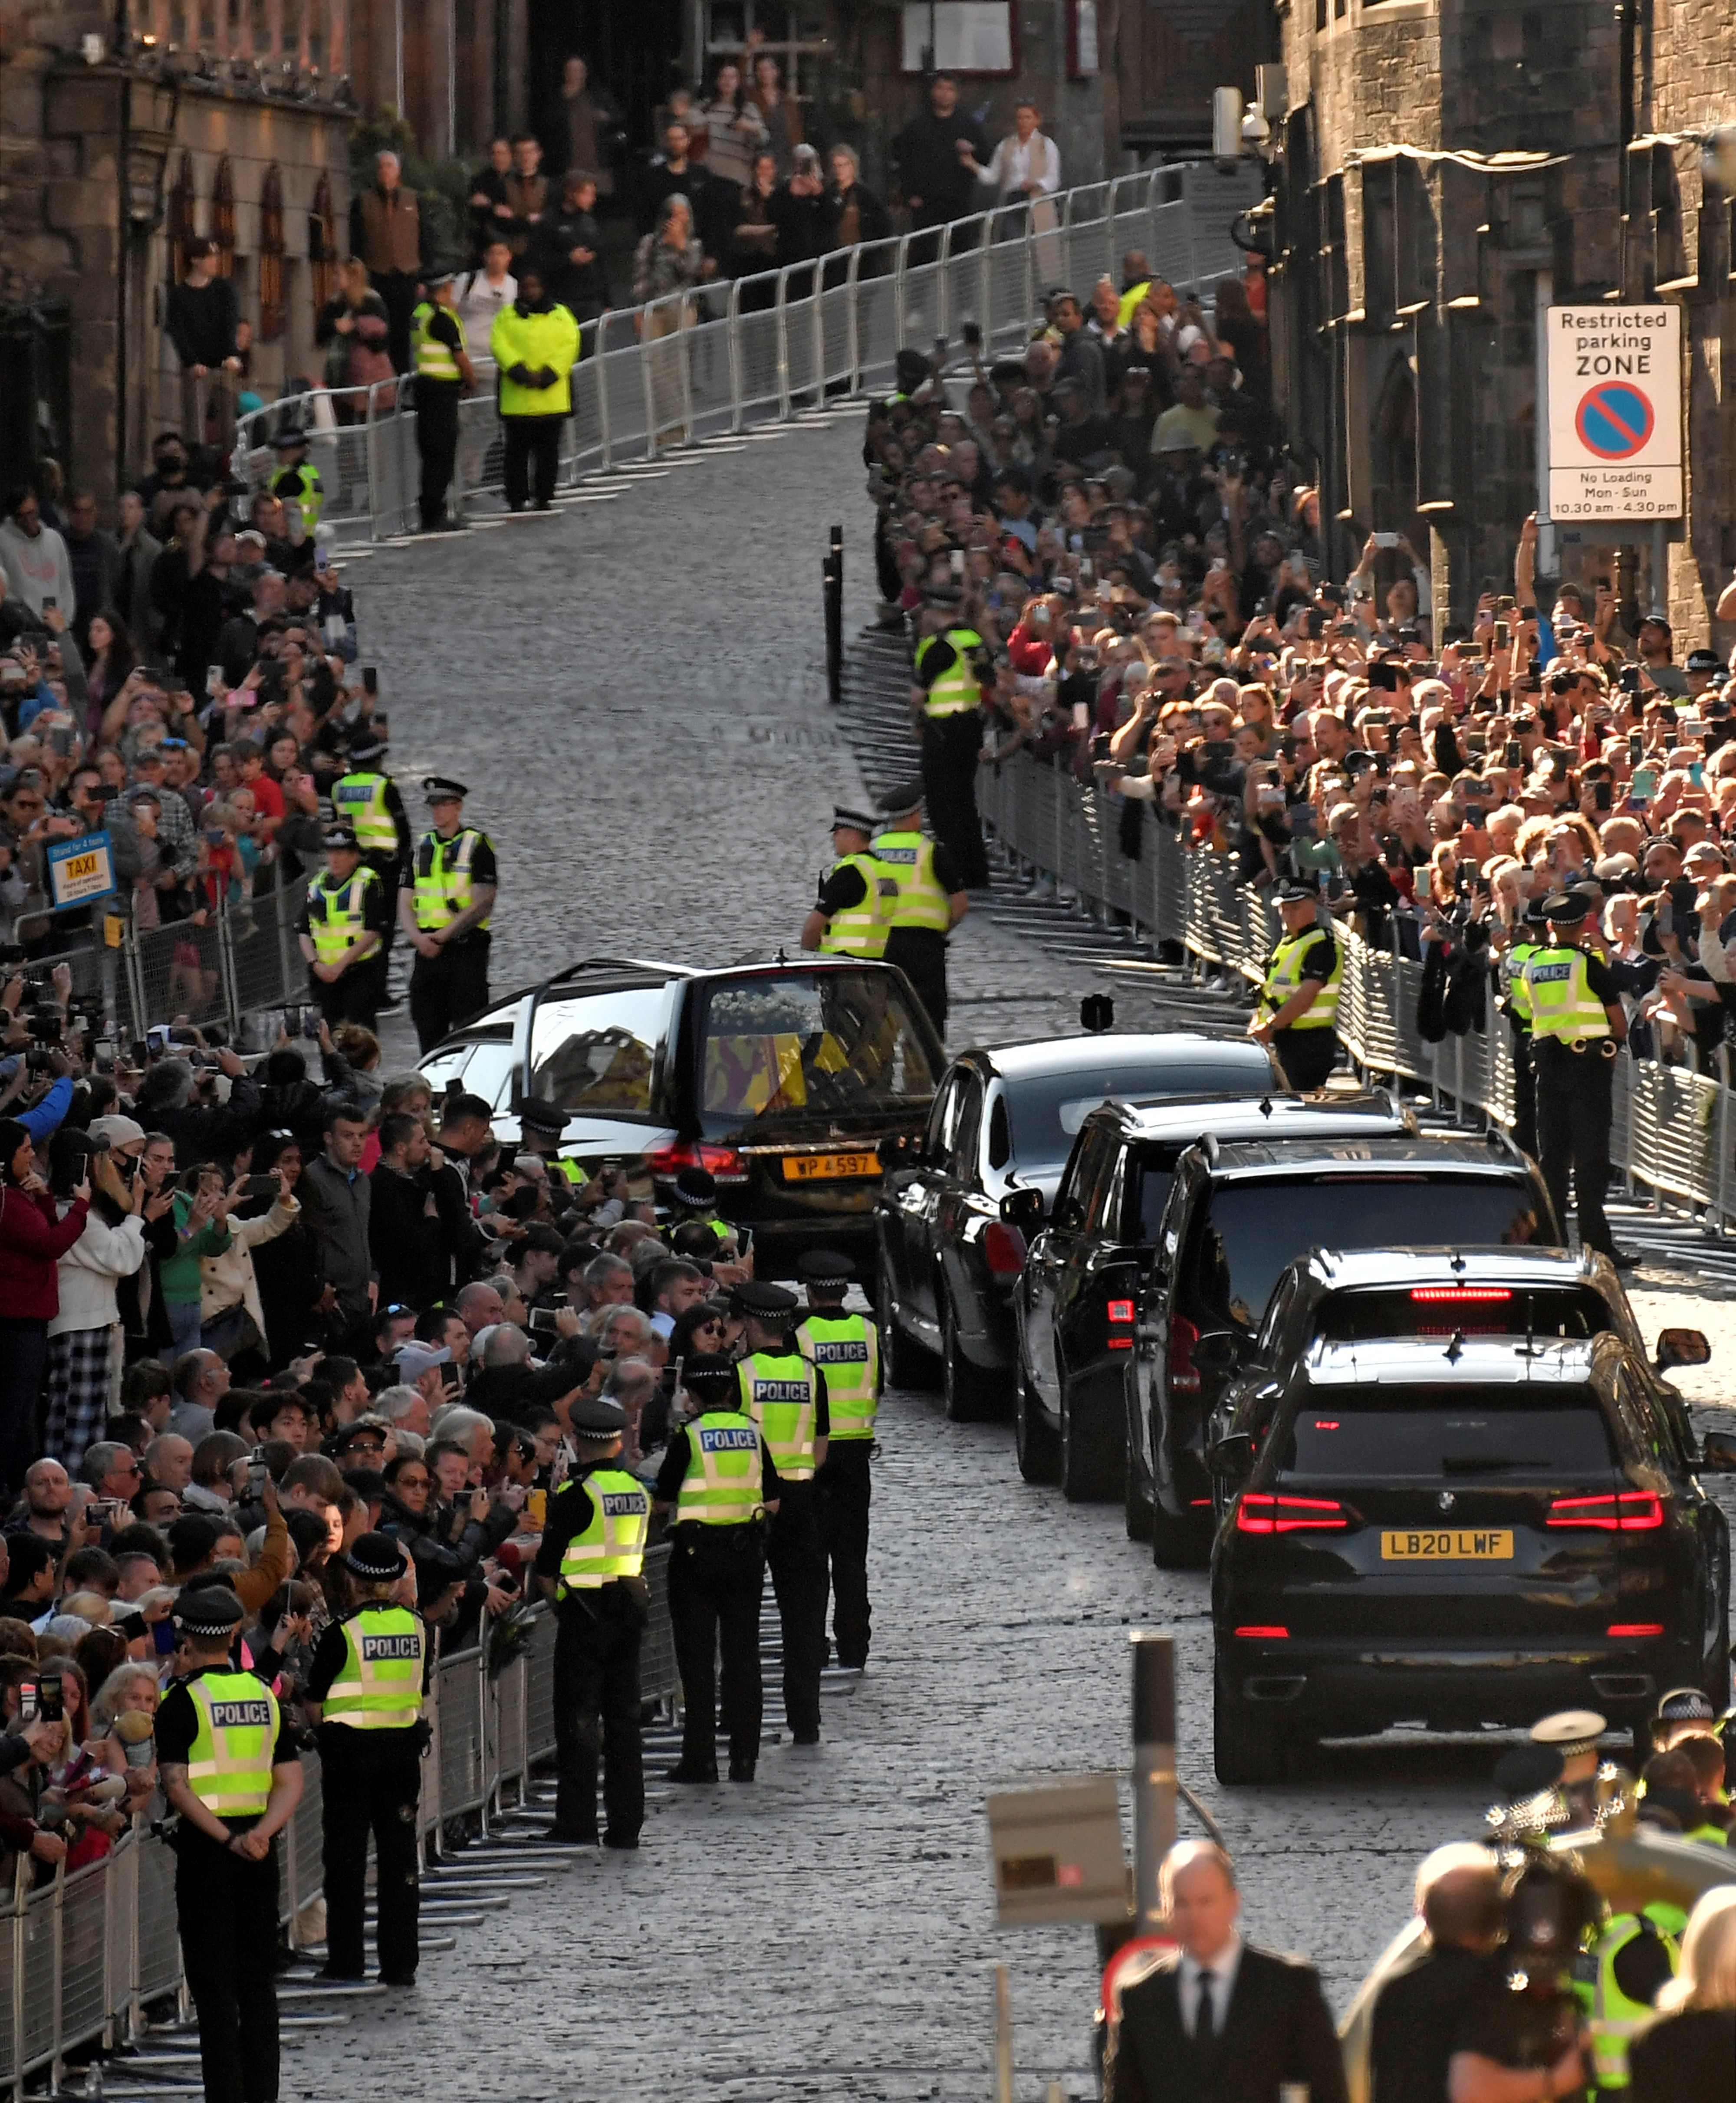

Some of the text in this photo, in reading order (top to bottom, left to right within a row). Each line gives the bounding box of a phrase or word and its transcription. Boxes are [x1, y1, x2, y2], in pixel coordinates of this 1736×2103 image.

[1561, 312, 1667, 329] Restricted
[1576, 333, 1652, 351] parking
[1576, 355, 1651, 376] ZONE
[1580, 472, 1652, 484] No Loading
[1585, 488, 1612, 498] Mon
[1622, 487, 1647, 497] Sun
[1555, 503, 1591, 513] 10.30
[1595, 504, 1614, 513] am
[1624, 502, 1655, 512] 4.30
[1658, 503, 1677, 513] pm
[66, 855, 95, 877] TAXI
[1532, 964, 1570, 980] POLICE
[816, 1343, 866, 1361] POLICE
[756, 1383, 809, 1400] POLICE
[703, 1430, 756, 1449] POLICE
[605, 1495, 646, 1513] POLICE
[1391, 1533, 1502, 1554] LB20 LWF
[365, 1637, 419, 1658] POLICE
[214, 1703, 269, 1724] POLICE
